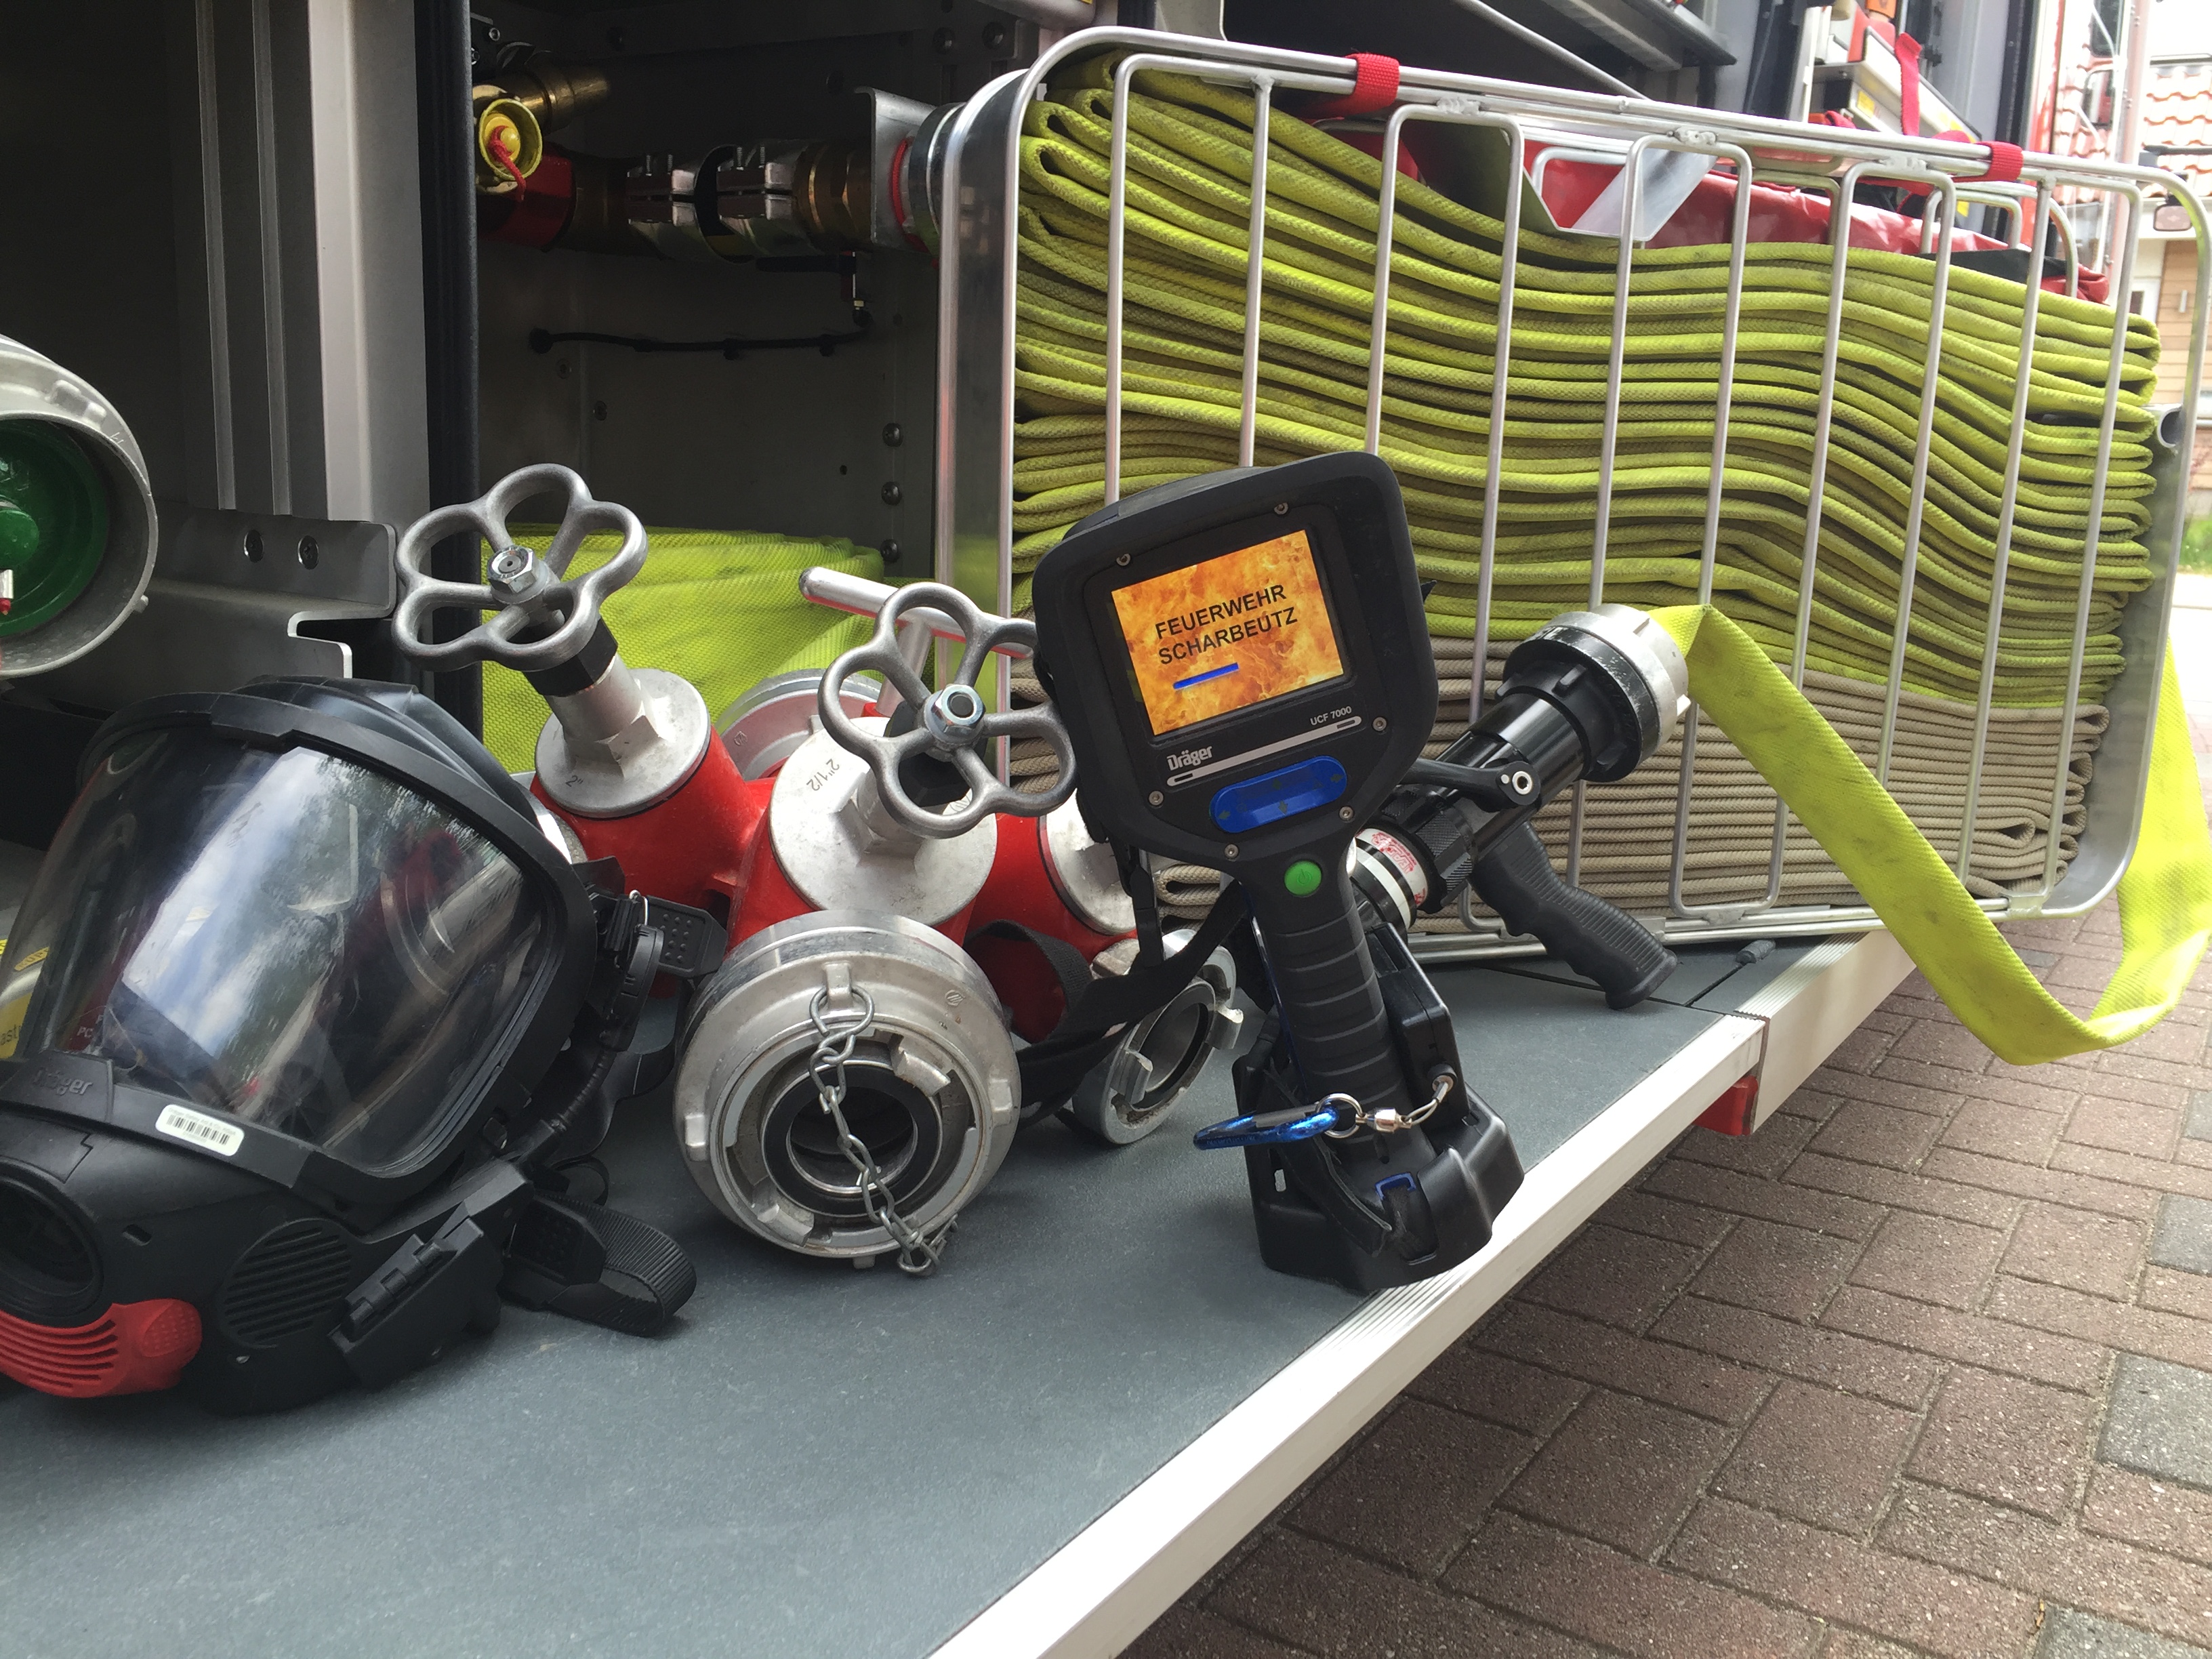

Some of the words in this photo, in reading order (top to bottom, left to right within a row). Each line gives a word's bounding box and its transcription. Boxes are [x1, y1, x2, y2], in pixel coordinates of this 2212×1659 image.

[1155, 584, 1287, 640] FEUERWEHR
[1158, 607, 1298, 665] SCHARBEUTZ
[1310, 713, 1329, 726] UCF
[1330, 705, 1352, 720] 7000
[1166, 745, 1213, 771] Dräger
